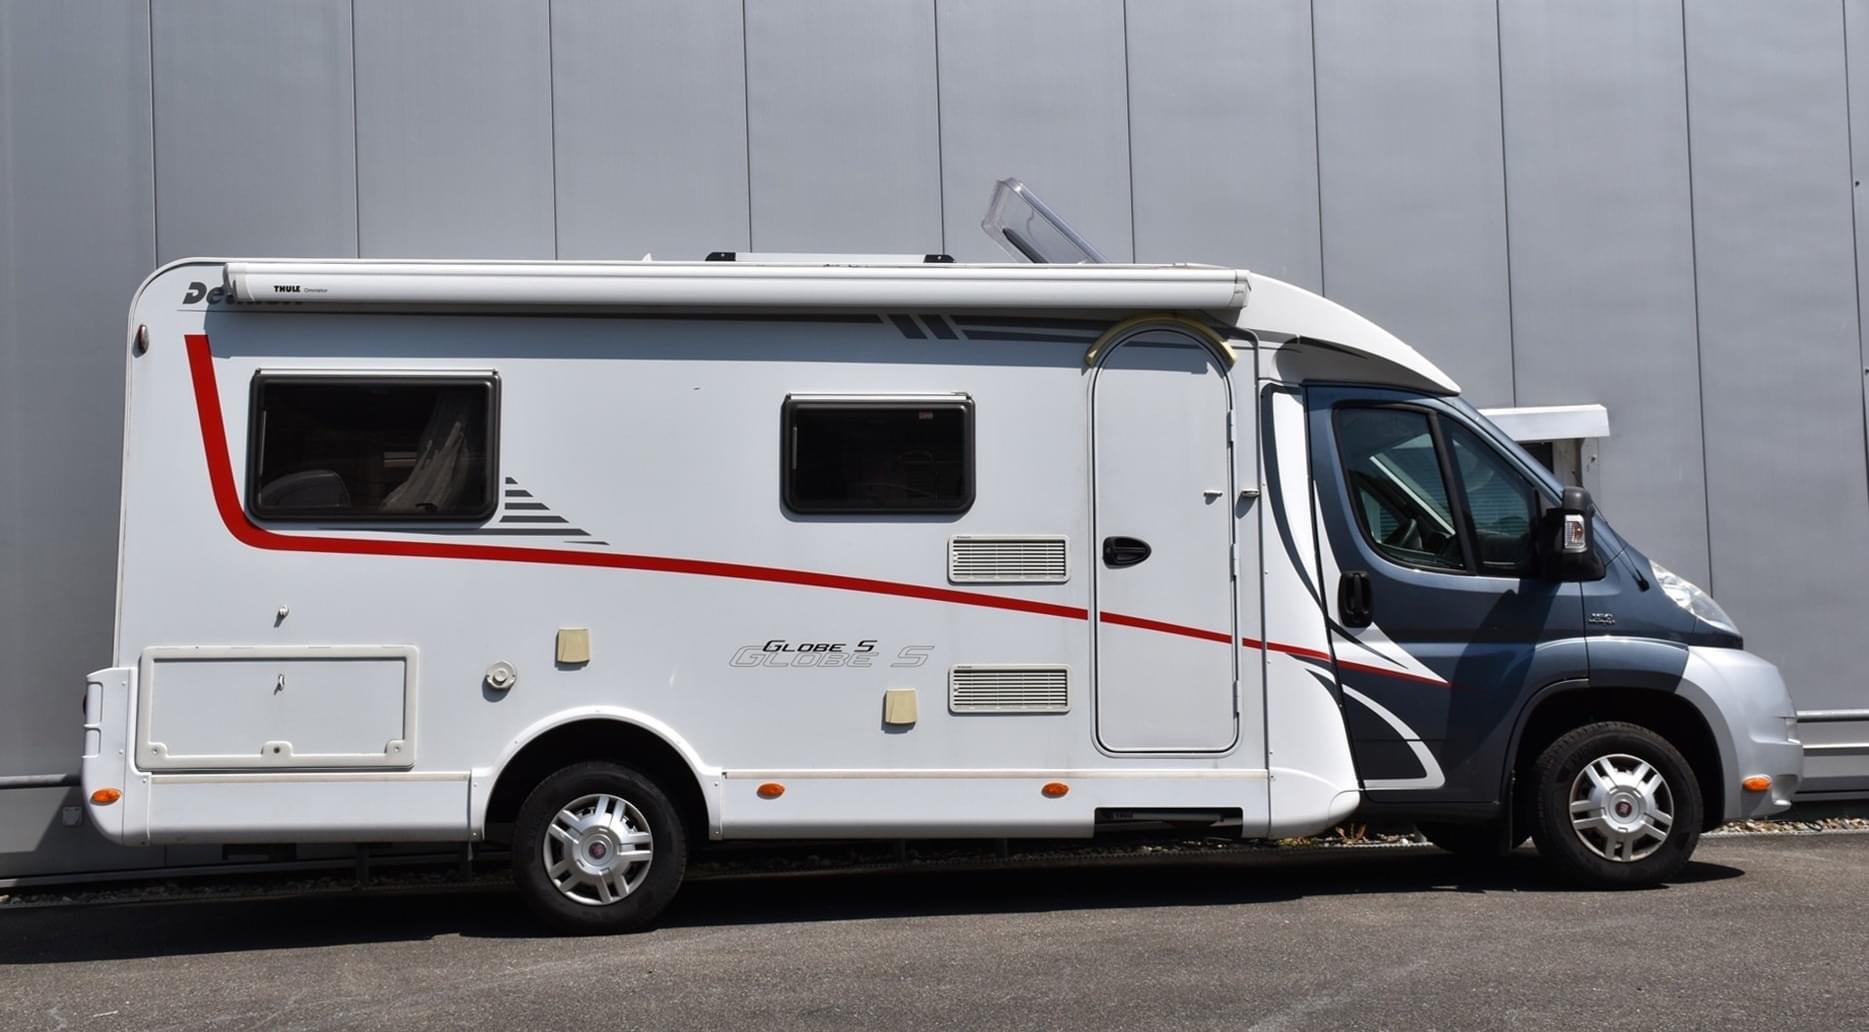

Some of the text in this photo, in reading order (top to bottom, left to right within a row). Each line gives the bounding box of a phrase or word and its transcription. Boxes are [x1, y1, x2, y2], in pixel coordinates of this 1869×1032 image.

[274, 285, 301, 293] THULE
[762, 640, 878, 653] GLOBE S
[890, 645, 935, 668] S
